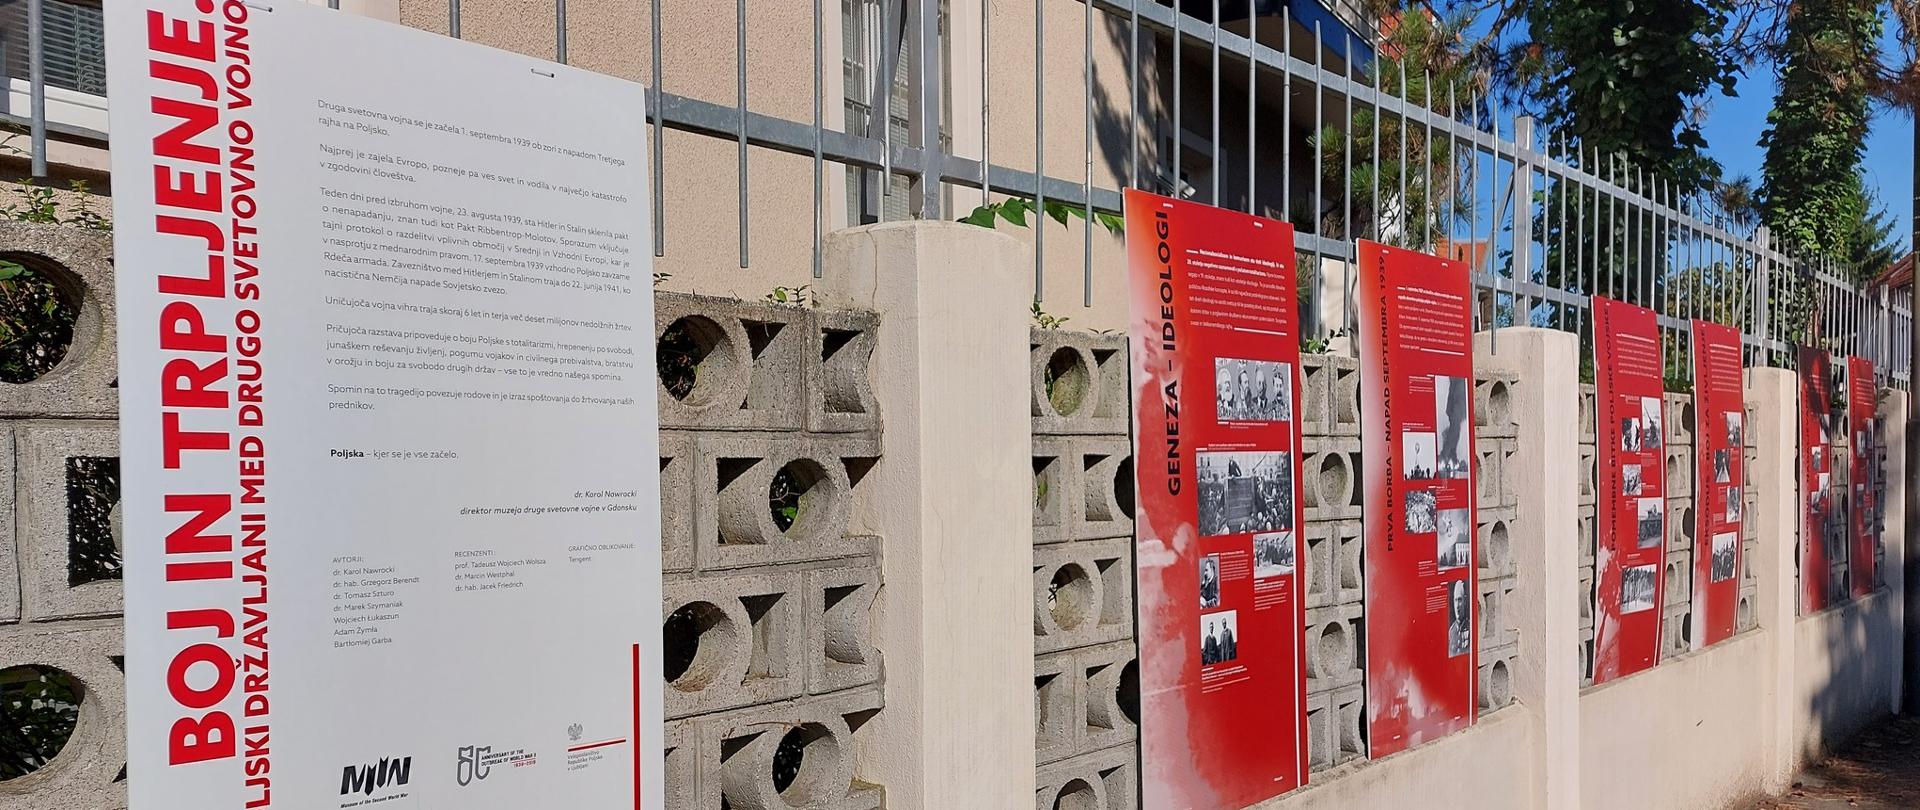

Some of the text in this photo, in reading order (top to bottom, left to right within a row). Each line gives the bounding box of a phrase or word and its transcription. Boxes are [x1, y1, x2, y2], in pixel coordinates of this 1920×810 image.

[317, 99, 346, 113] Druga
[347, 107, 387, 120] svetovna
[388, 114, 412, 125] vojna
[413, 119, 423, 127] se
[424, 120, 433, 129] je
[433, 123, 460, 134] začela
[469, 130, 511, 143] septembra
[513, 137, 530, 147] 1939
[531, 141, 542, 149] ob
[542, 144, 556, 152] zori
[562, 148, 596, 159] napadom
[597, 153, 625, 166] Tretjega
[318, 117, 341, 127] rajha
[356, 122, 391, 135] Poljsko.
[319, 143, 353, 158] Najprej
[356, 150, 365, 159] je
[367, 153, 394, 163] zajela
[432, 164, 465, 176] pozneje
[468, 170, 480, 178] pa
[497, 175, 514, 184] svet
[526, 181, 549, 189] vodila
[558, 186, 589, 197] največjo
[591, 190, 627, 203] katastrofo
[327, 162, 371, 174] zgodovini
[372, 168, 417, 182] človeštva.
[323, 251, 352, 262] Rdeča
[391, 259, 441, 272] Zavezništvo
[443, 266, 461, 274] med
[463, 268, 499, 279] Hitlerjem
[500, 271, 508, 280] in
[509, 272, 542, 283] Stalinom
[543, 278, 560, 287] traja
[560, 279, 570, 287] do
[583, 282, 602, 292] junija
[622, 286, 631, 296] ko
[324, 269, 508, 294] nacistična Nemčija napade Sovjetsko zvezo.
[1156, 212, 1176, 350] IDEOLOGI
[1380, 297, 1390, 383] SEPTEMBRA
[148, 0, 236, 765] BOJ IN TRPLJENJE.
[223, 0, 271, 808] LJSKI DRŽAVLJANI MED DRUGO SVETOVNO VOJNO
[328, 400, 375, 409] prednikov.
[1165, 381, 1181, 497] GENEZA
[1383, 388, 1391, 441] NAPAD
[330, 449, 364, 459] Poljska
[373, 449, 389, 459] kjer
[403, 449, 411, 460] je
[574, 490, 583, 498] dr.
[1385, 457, 1393, 508] BORBA
[493, 506, 522, 515] muzeja
[523, 506, 545, 515] druge
[580, 504, 600, 513] vojne
